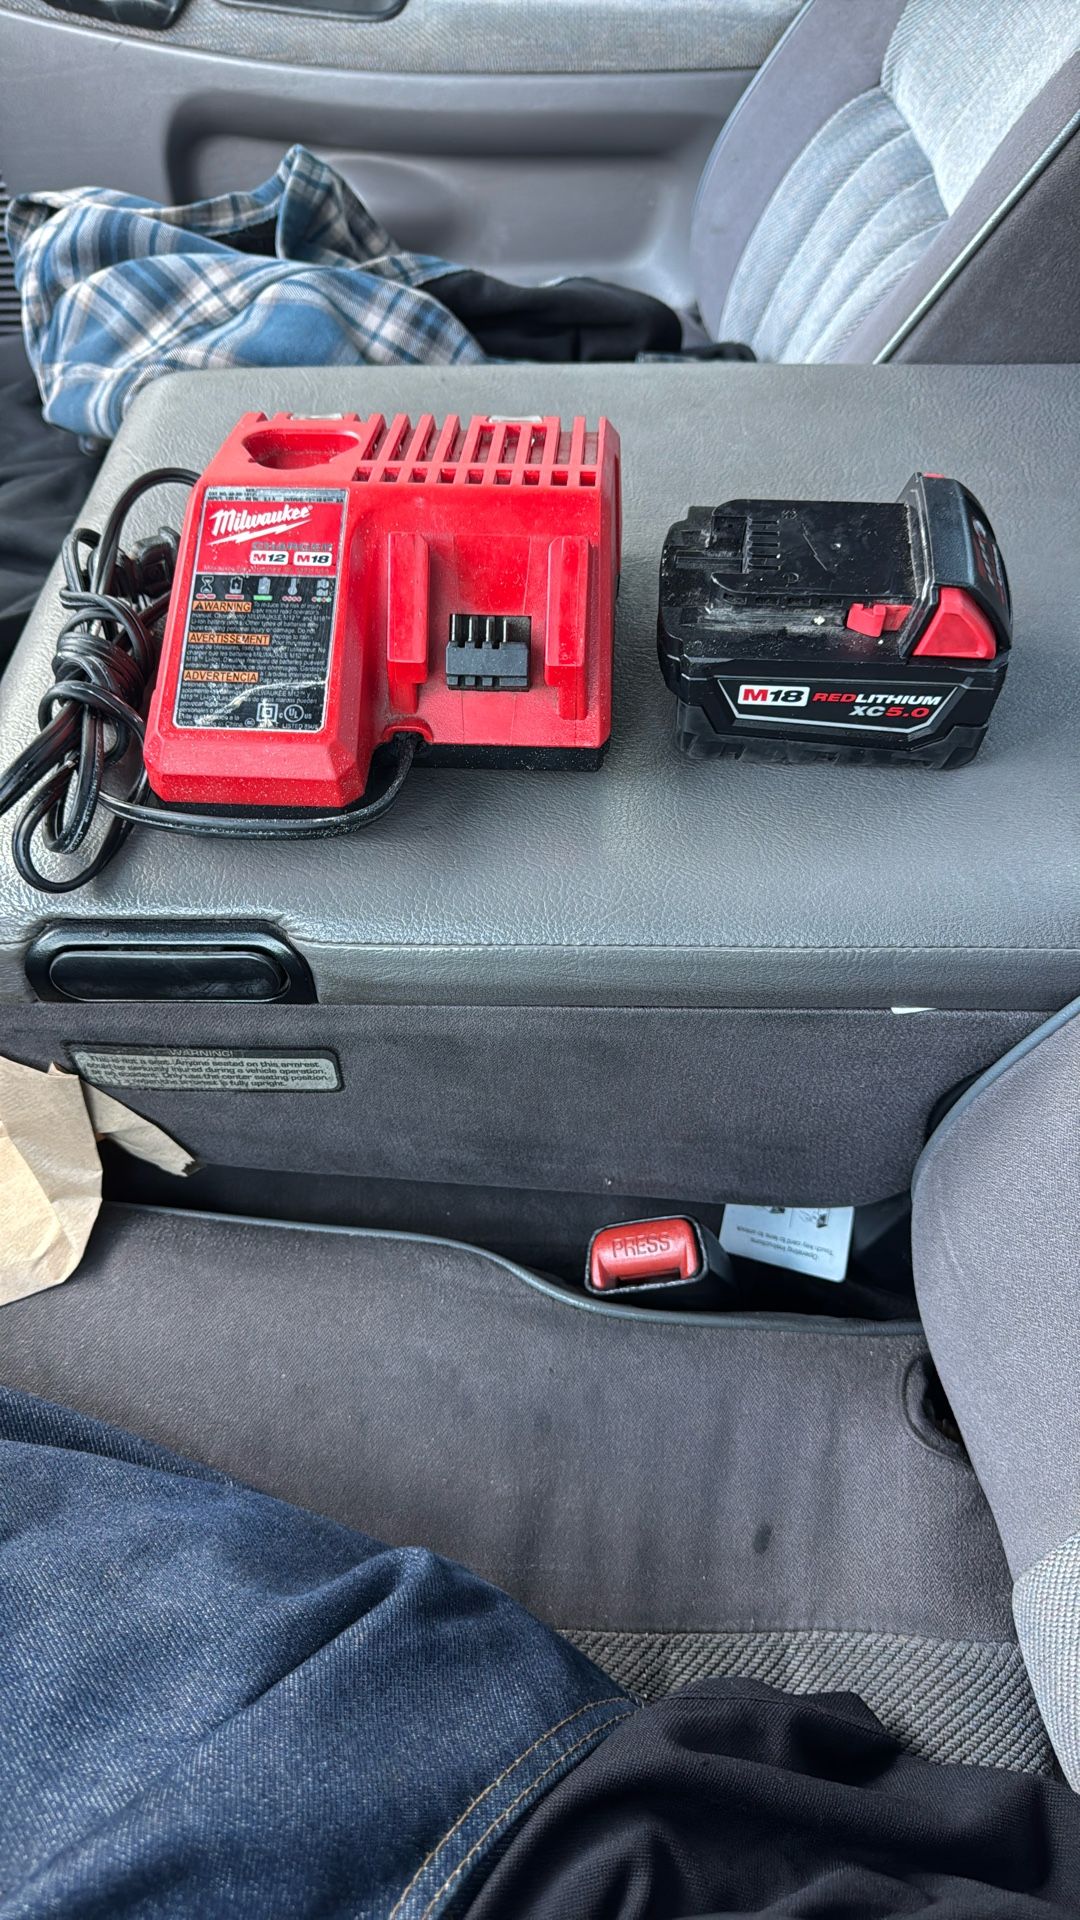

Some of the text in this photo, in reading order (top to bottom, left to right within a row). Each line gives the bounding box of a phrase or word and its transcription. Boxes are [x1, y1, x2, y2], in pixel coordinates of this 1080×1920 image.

[209, 504, 312, 536] Milwaukee
[252, 552, 331, 564] M12 M18
[203, 601, 251, 612] WARNING
[190, 633, 269, 644] AVERTISSEMENT
[184, 671, 257, 682] ADVERTENCIA
[742, 688, 942, 706] M18 REDLITHIUM
[288, 707, 299, 719] UL
[849, 705, 930, 718] XC5.0
[168, 1049, 233, 1057] WARNING!
[611, 1233, 671, 1259] PRESS
